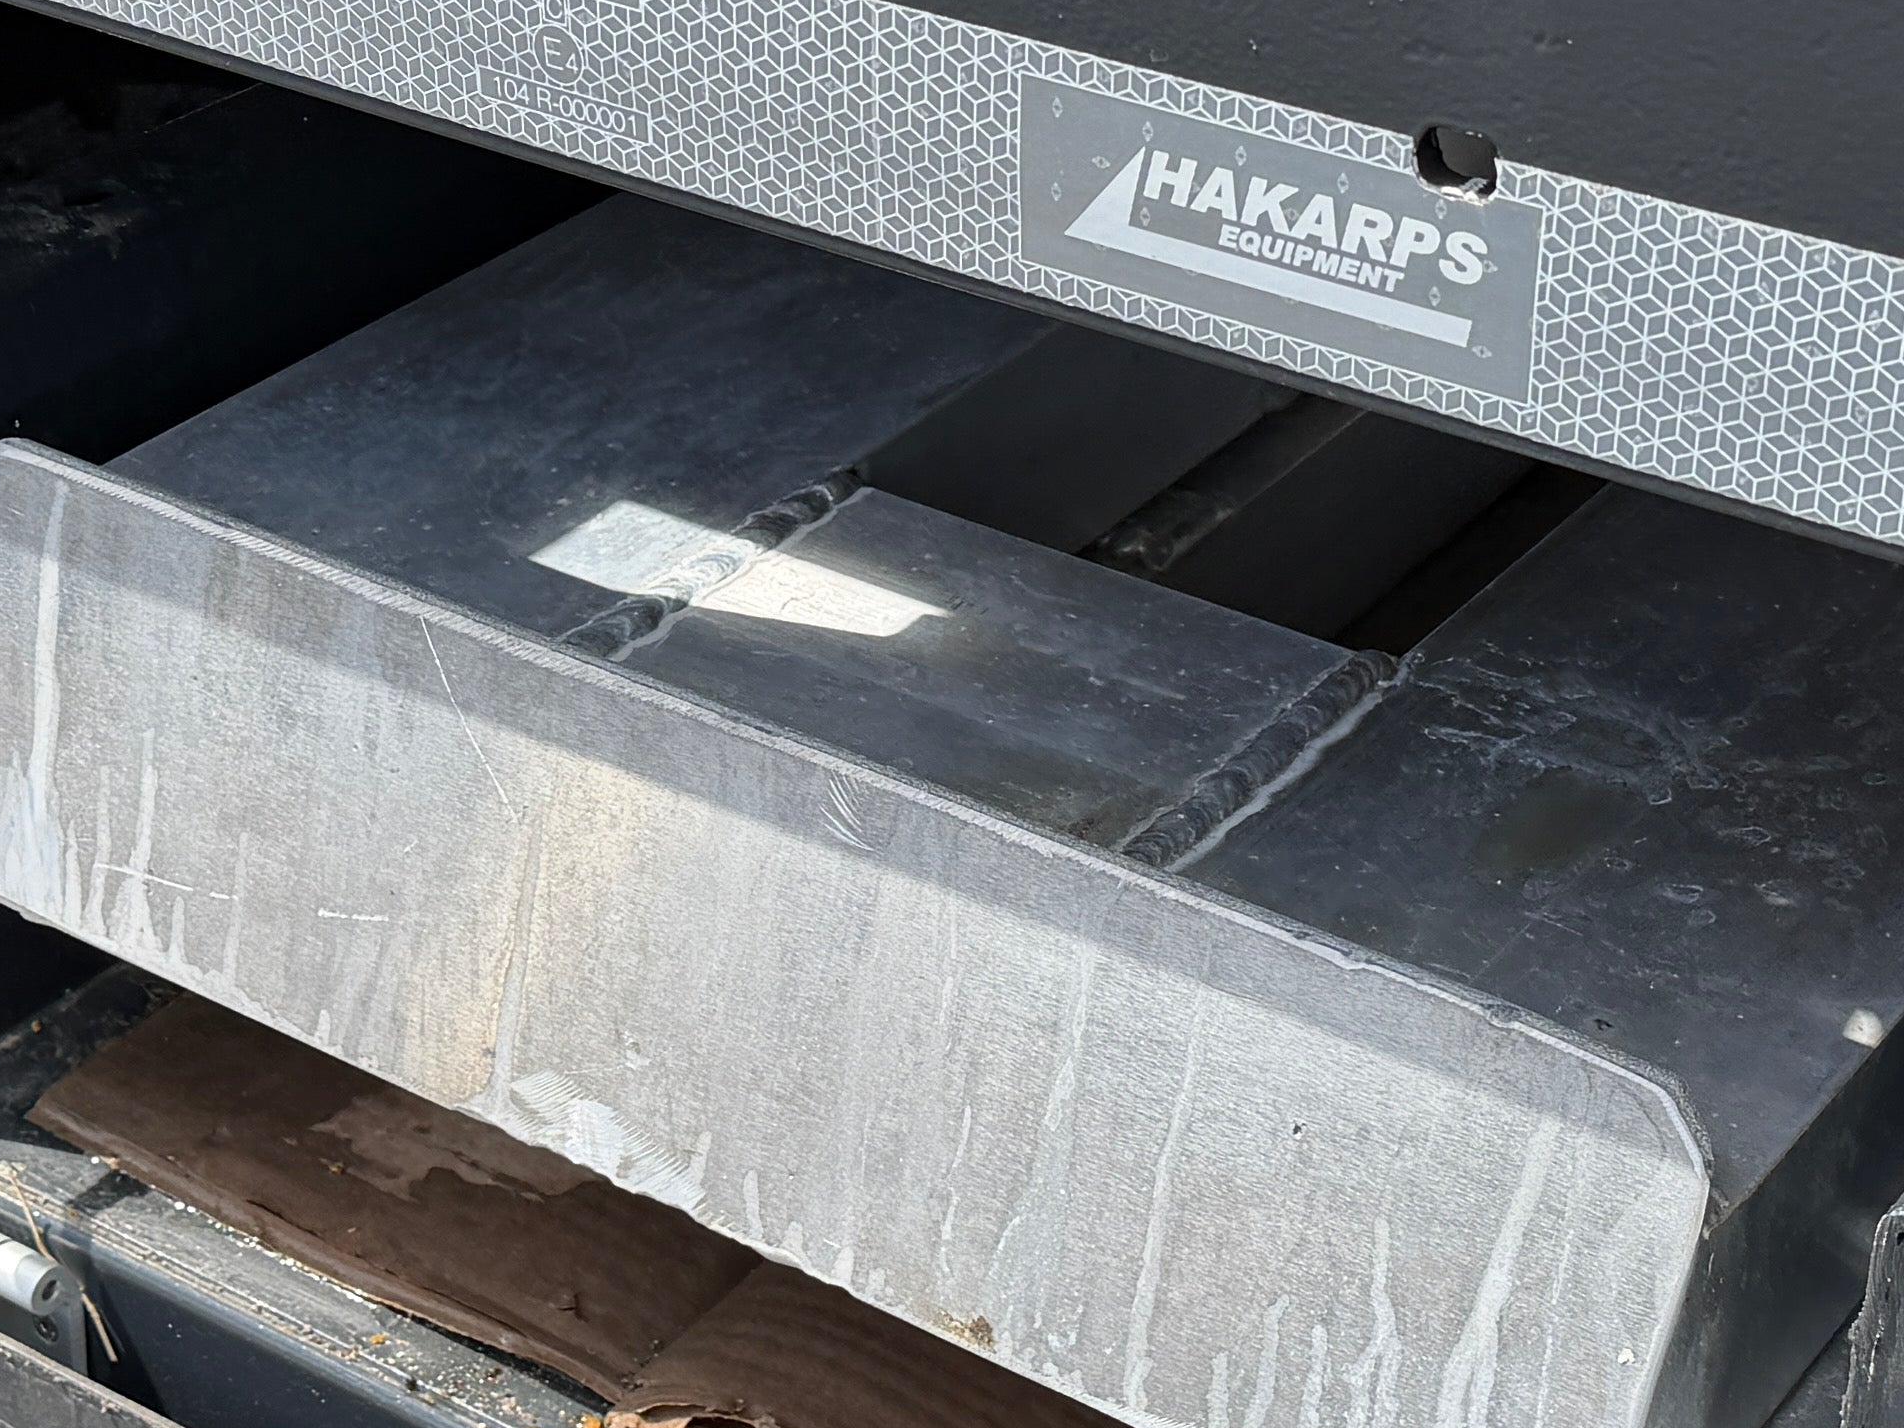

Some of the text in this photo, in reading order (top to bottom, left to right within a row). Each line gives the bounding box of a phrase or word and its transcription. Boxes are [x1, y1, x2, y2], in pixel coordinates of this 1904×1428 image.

[493, 77, 637, 136] 104 R-000001
[1143, 151, 1488, 284] HAKARPS
[1218, 224, 1405, 293] EQUIPMENT
